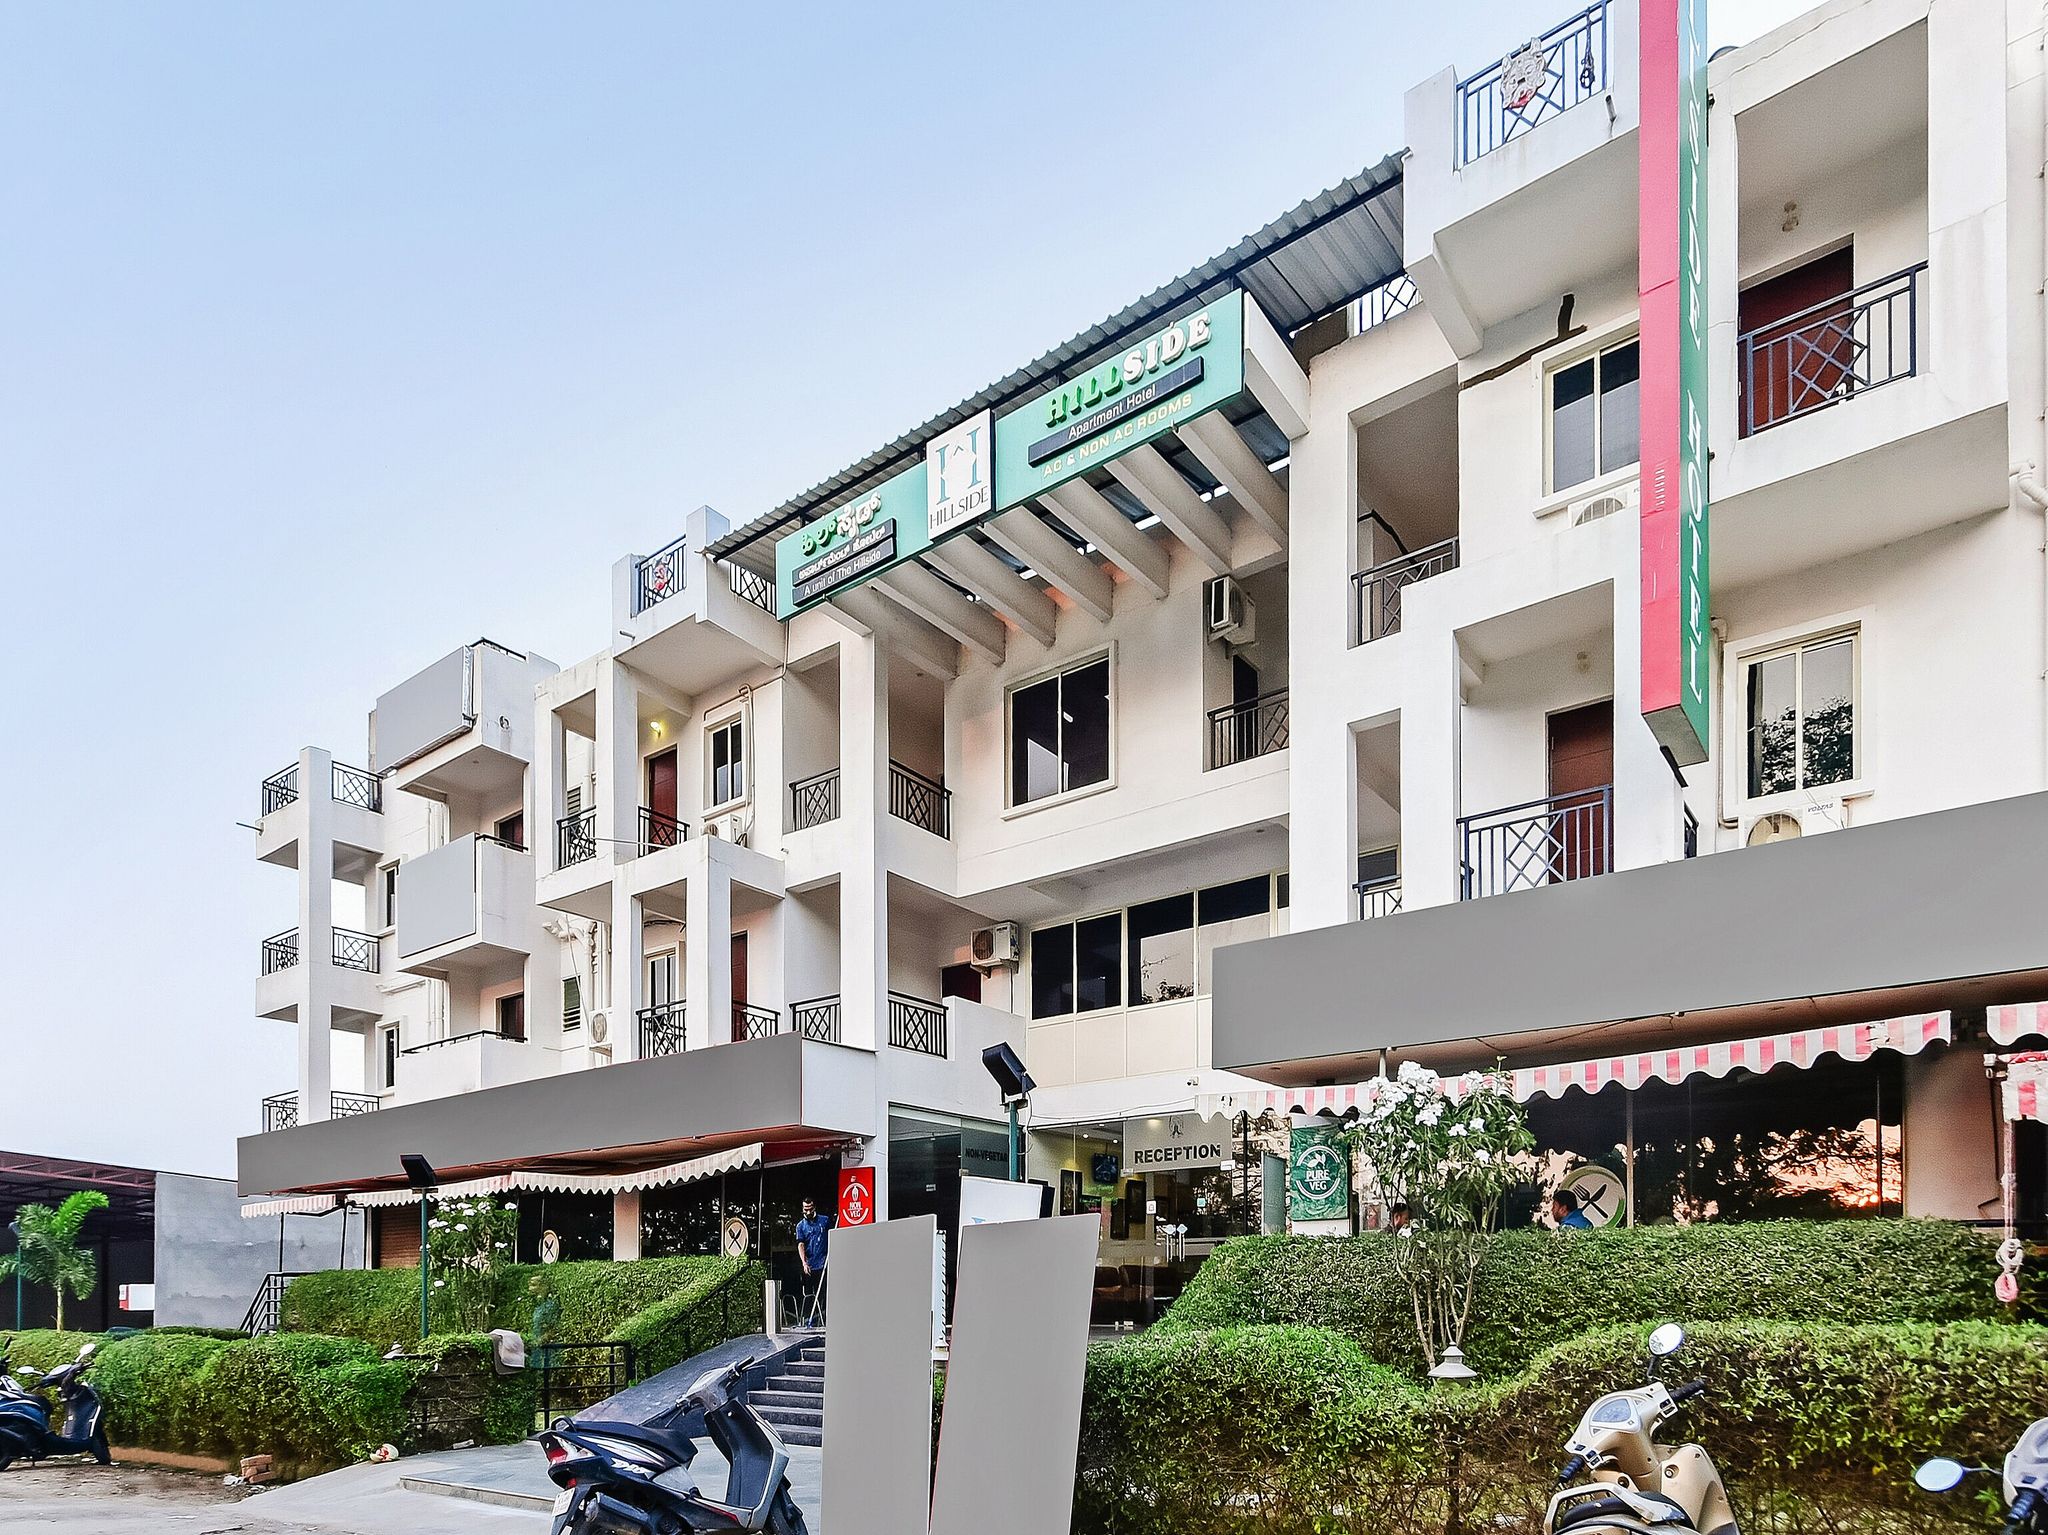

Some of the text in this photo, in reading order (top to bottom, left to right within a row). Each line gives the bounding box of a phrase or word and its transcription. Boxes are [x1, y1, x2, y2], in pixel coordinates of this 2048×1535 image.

[1046, 312, 1211, 427] HILLSIDE
[1043, 393, 1192, 477] AC & NON AC ROOMS
[1068, 384, 1156, 440] Apartment Hotel
[930, 486, 988, 529] HILLSIDE
[1687, 389, 1702, 704] HOTEL
[803, 550, 881, 596] A unit of The Hillside
[1134, 1144, 1221, 1164] RECEPTION
[1306, 1170, 1330, 1180] PURE
[1309, 1181, 1327, 1190] VEG
